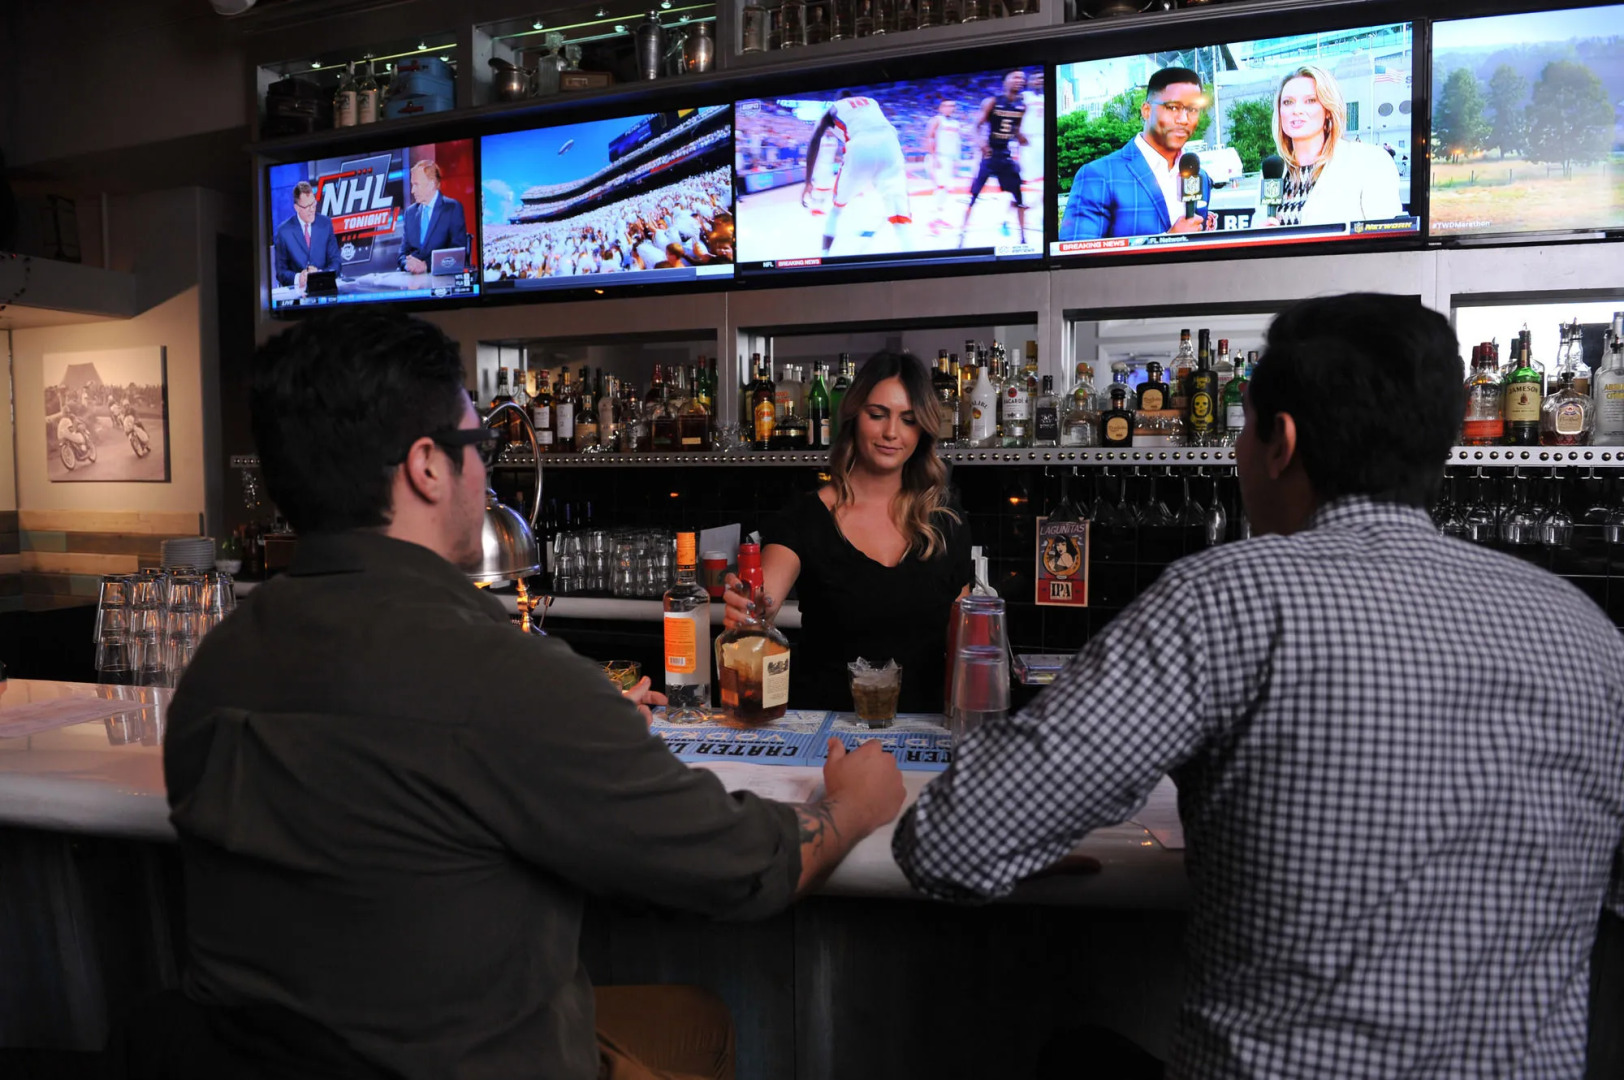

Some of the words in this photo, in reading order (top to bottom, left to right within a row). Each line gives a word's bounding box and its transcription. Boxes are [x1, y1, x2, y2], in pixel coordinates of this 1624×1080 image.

[321, 173, 393, 217] NHL
[343, 211, 389, 230] TONIGHT
[1365, 222, 1412, 231] NETWORK
[1063, 242, 1100, 251] BREAKING
[1103, 240, 1125, 248] NEWS
[1508, 385, 1538, 395] JAMESON
[1040, 524, 1085, 536] LAGUNITAS
[1051, 582, 1071, 597] IPA
[658, 730, 786, 742] VODKA
[696, 742, 799, 757] CRATER
